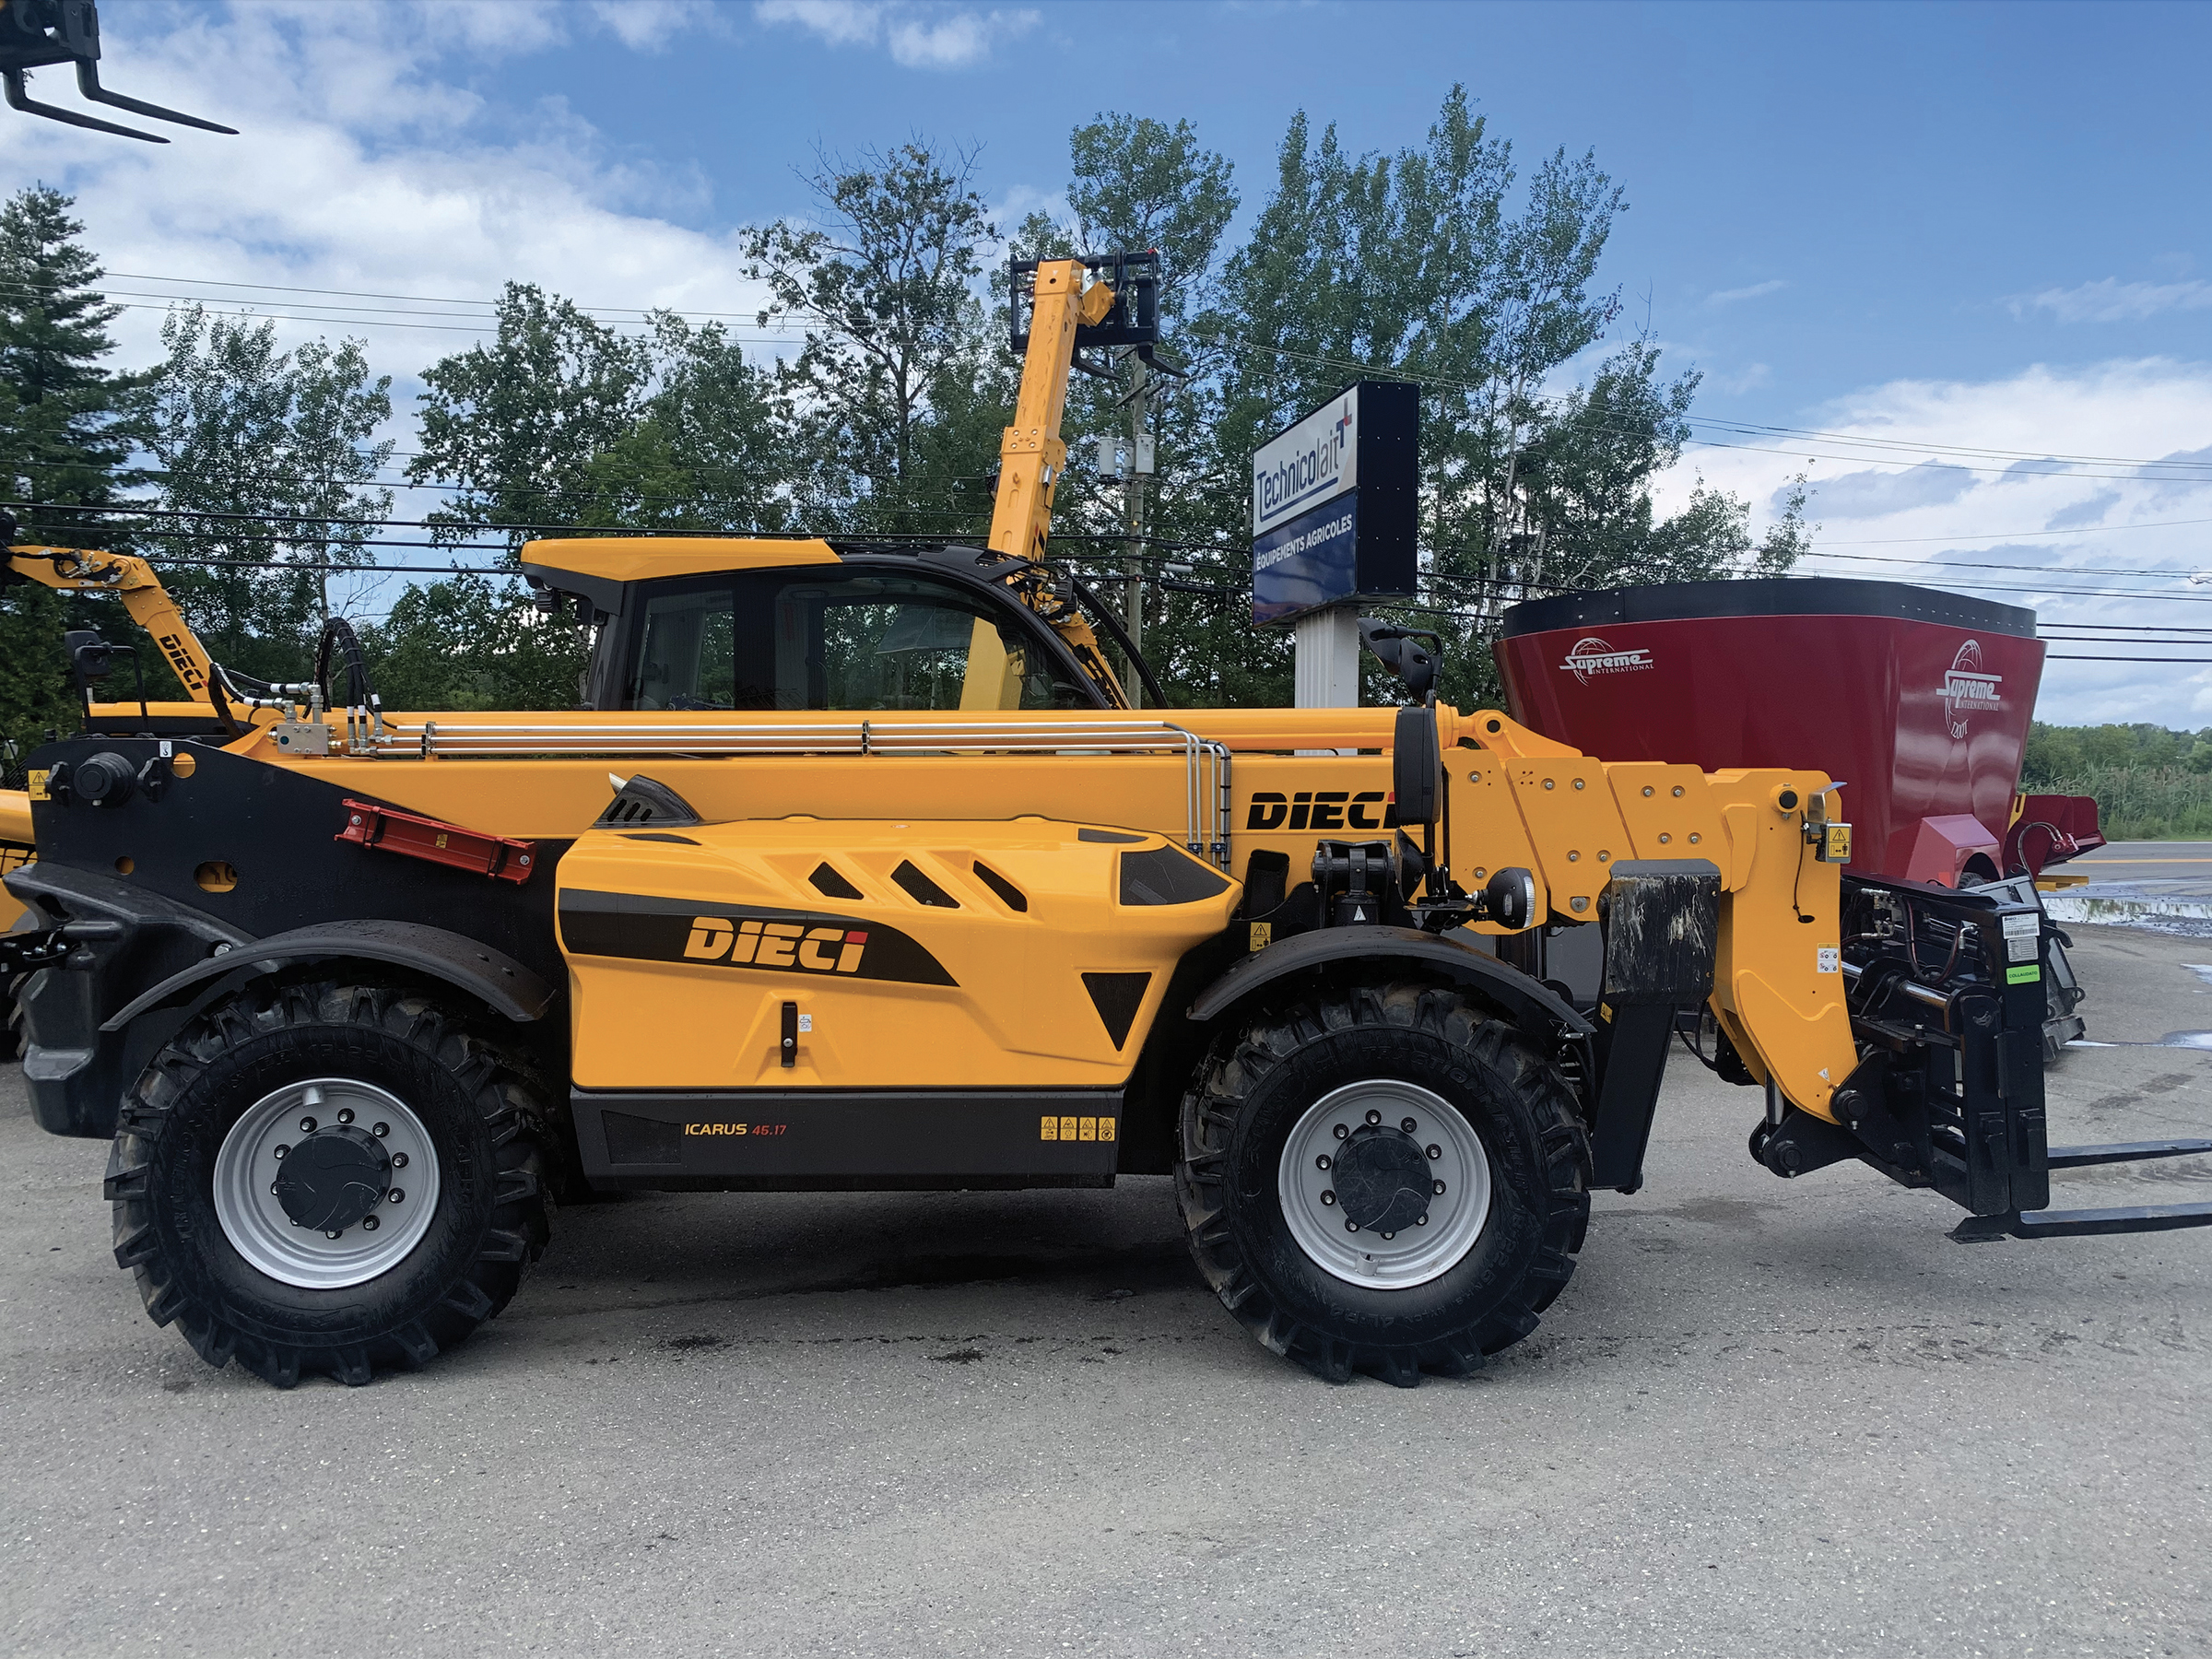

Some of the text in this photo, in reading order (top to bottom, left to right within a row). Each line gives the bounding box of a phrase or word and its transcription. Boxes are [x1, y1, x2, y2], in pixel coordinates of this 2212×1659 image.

[1256, 429, 1339, 514] Technicolait
[1256, 513, 1352, 571] ÉQUIPEMENTS AGRICOLES
[159, 634, 208, 690] DIECI
[1559, 649, 1653, 675] Supreme
[1593, 664, 1654, 675] INTERNATIONAL
[1936, 670, 2002, 709] Supreme
[1959, 700, 1999, 711] INTERNATIONAL
[683, 916, 868, 973] DIECI
[2008, 971, 2039, 979] COLLAUDATO
[685, 1124, 787, 1135] ICARUS 45.17
